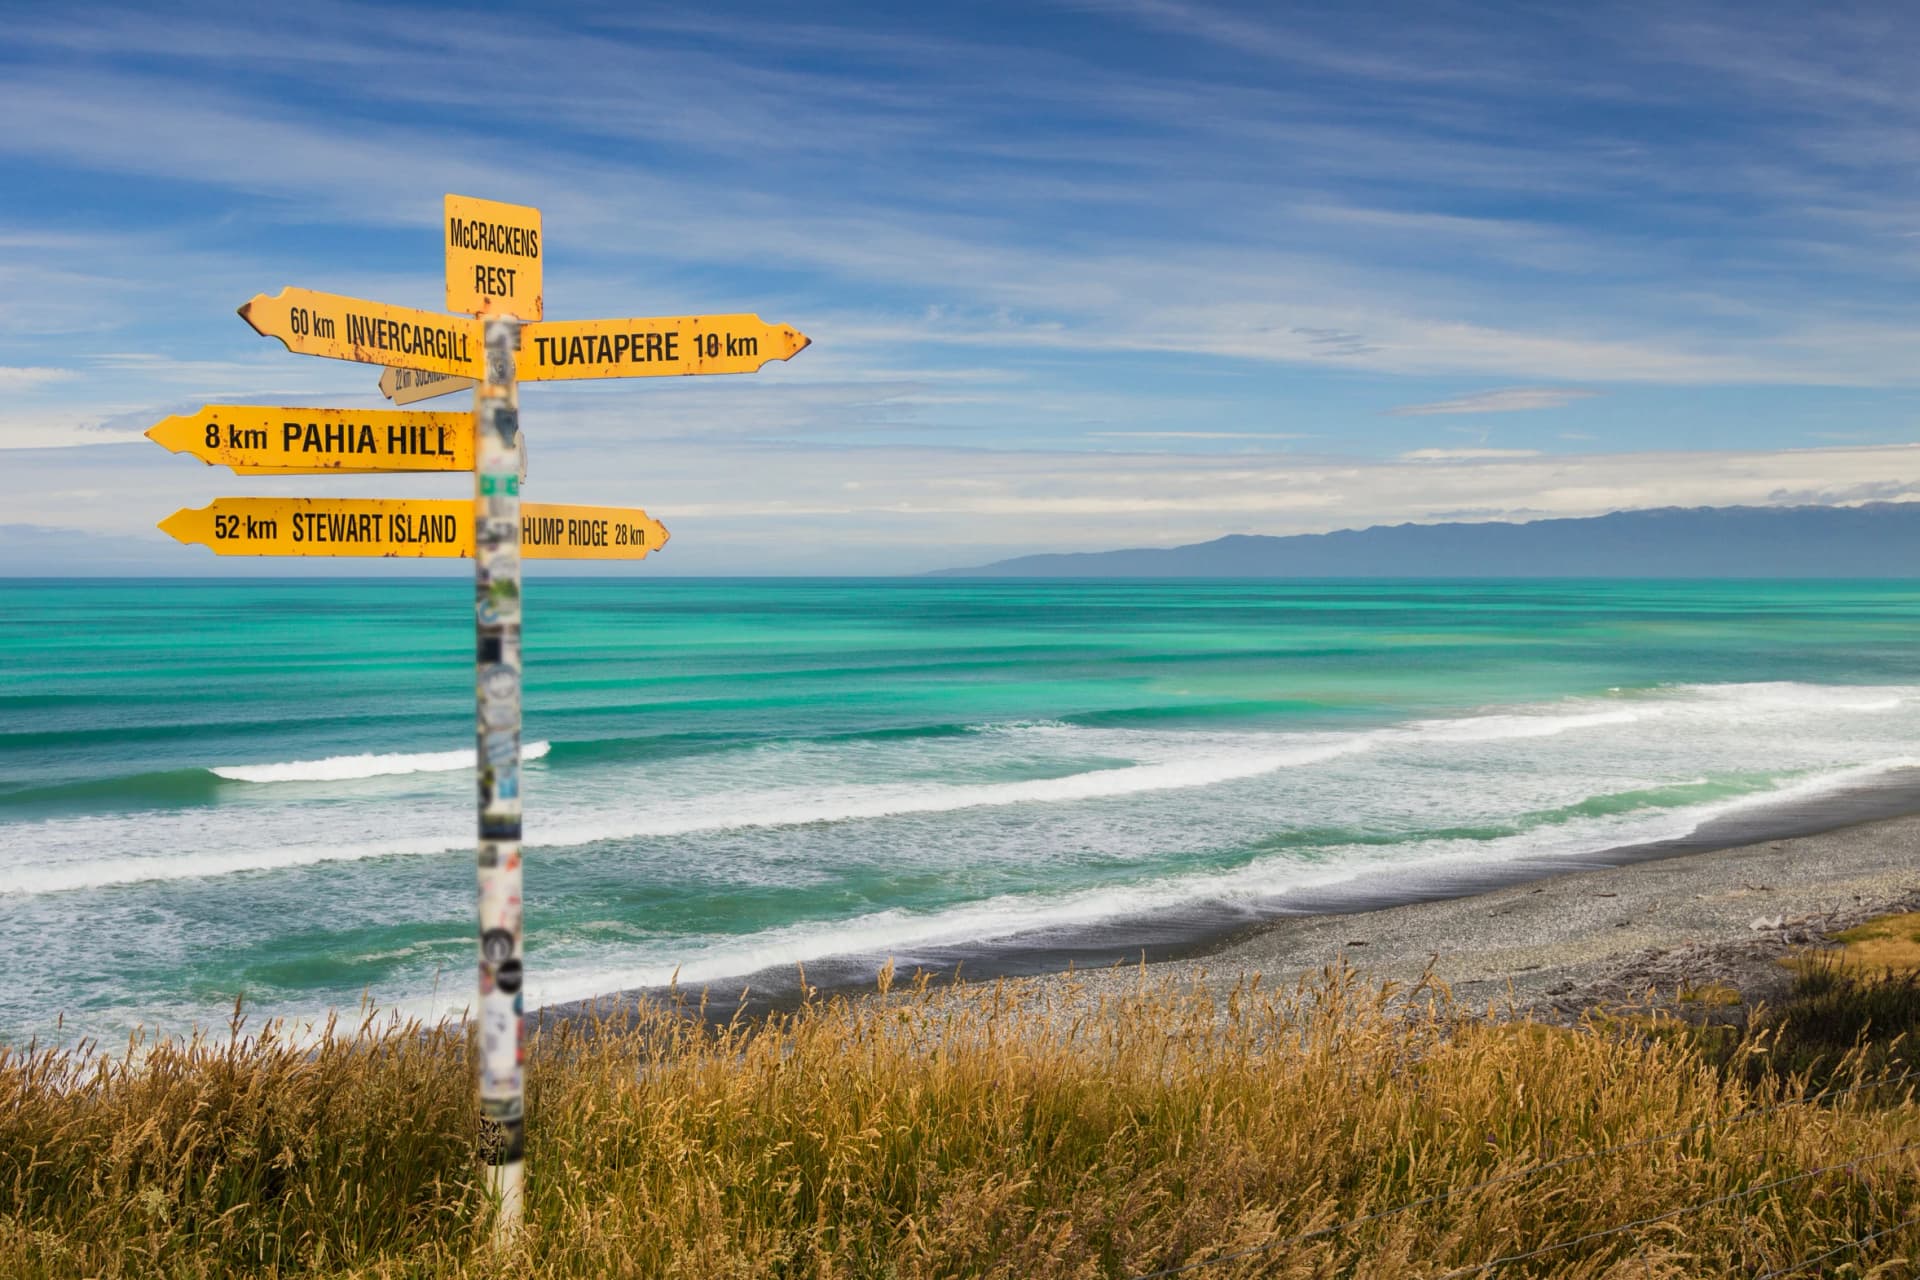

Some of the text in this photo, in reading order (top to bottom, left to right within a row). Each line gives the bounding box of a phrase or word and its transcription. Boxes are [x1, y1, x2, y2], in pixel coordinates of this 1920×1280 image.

[450, 217, 538, 258] McCRACKENS
[475, 265, 516, 297] REST
[290, 307, 472, 363] 60 km INVERCARGILL
[534, 331, 758, 366] TUATAPERE 10 km
[395, 369, 402, 391] 22
[204, 423, 454, 456] 8 km PAHIA HILL
[214, 513, 456, 544] 52 km STEWART ISLAND
[522, 517, 644, 546] HUMP RIDGE 28 km
